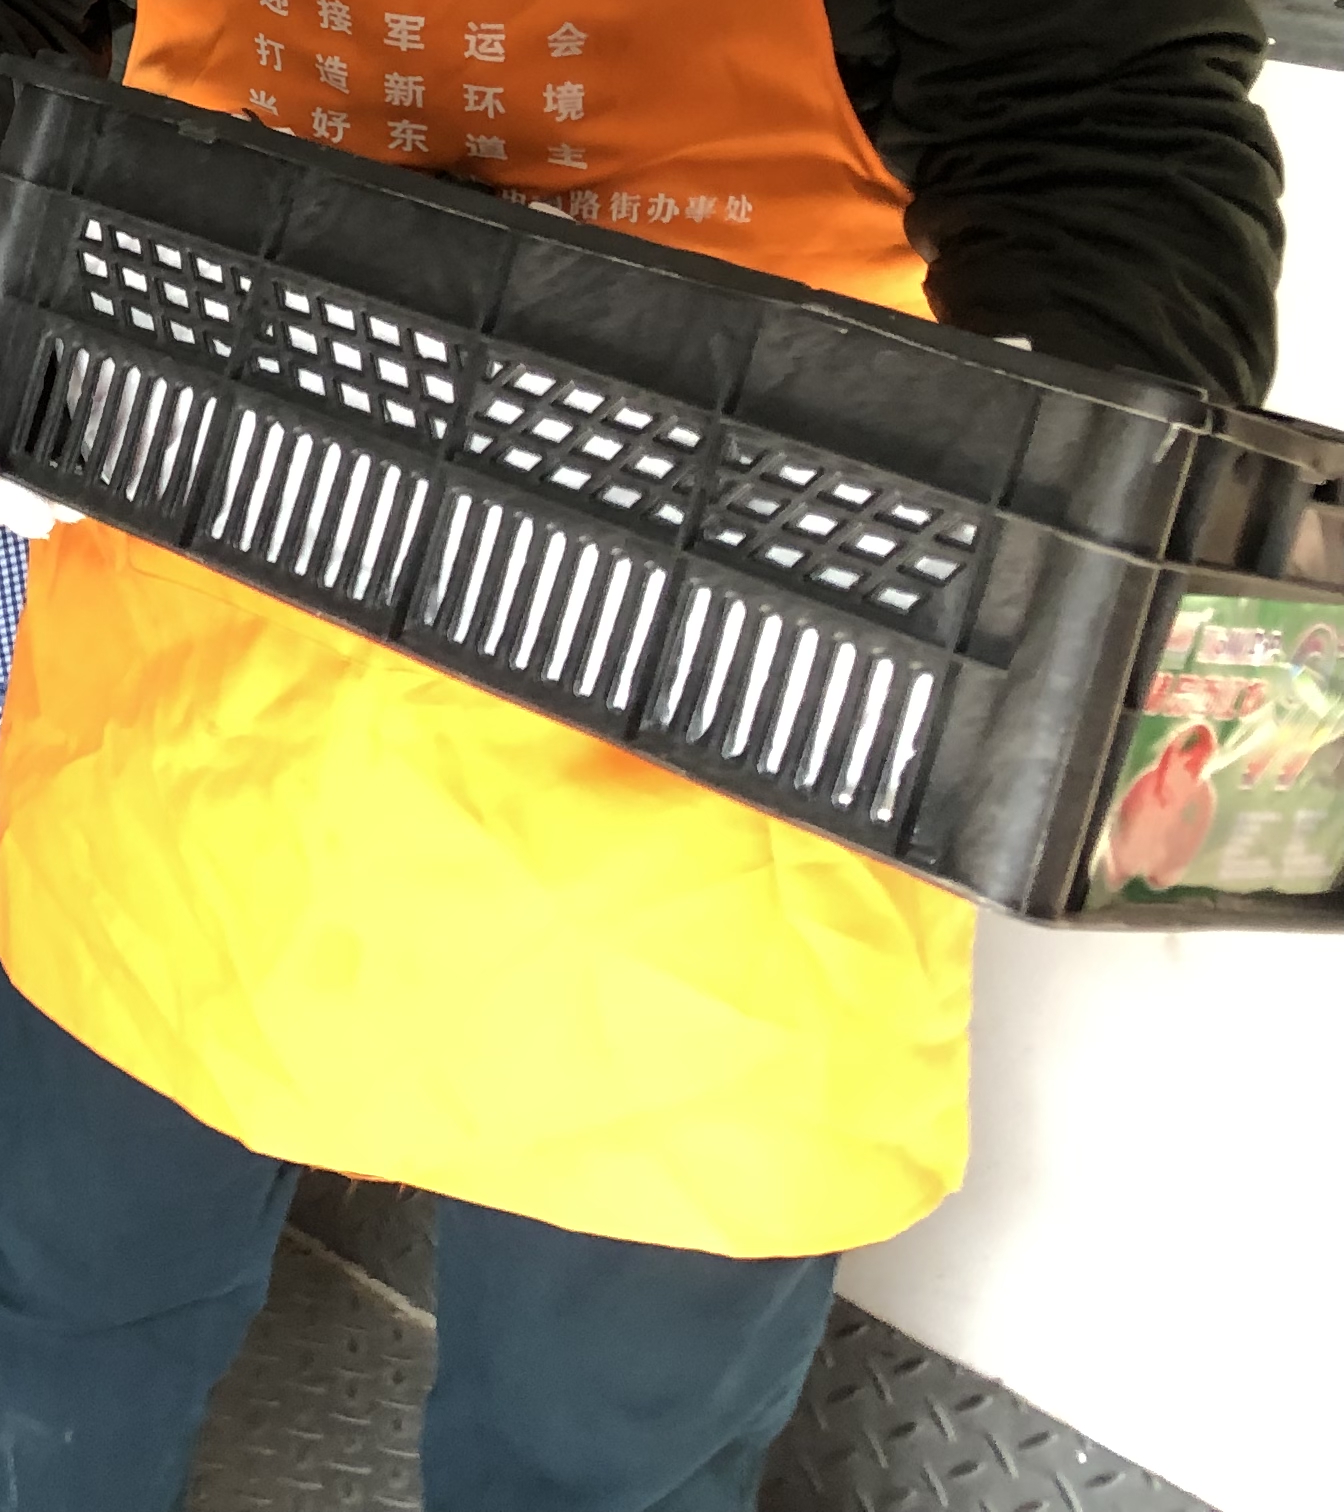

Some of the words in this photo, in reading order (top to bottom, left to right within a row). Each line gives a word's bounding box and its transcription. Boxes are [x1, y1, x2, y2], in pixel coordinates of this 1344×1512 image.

[254, 36, 586, 120] 打造新环境
